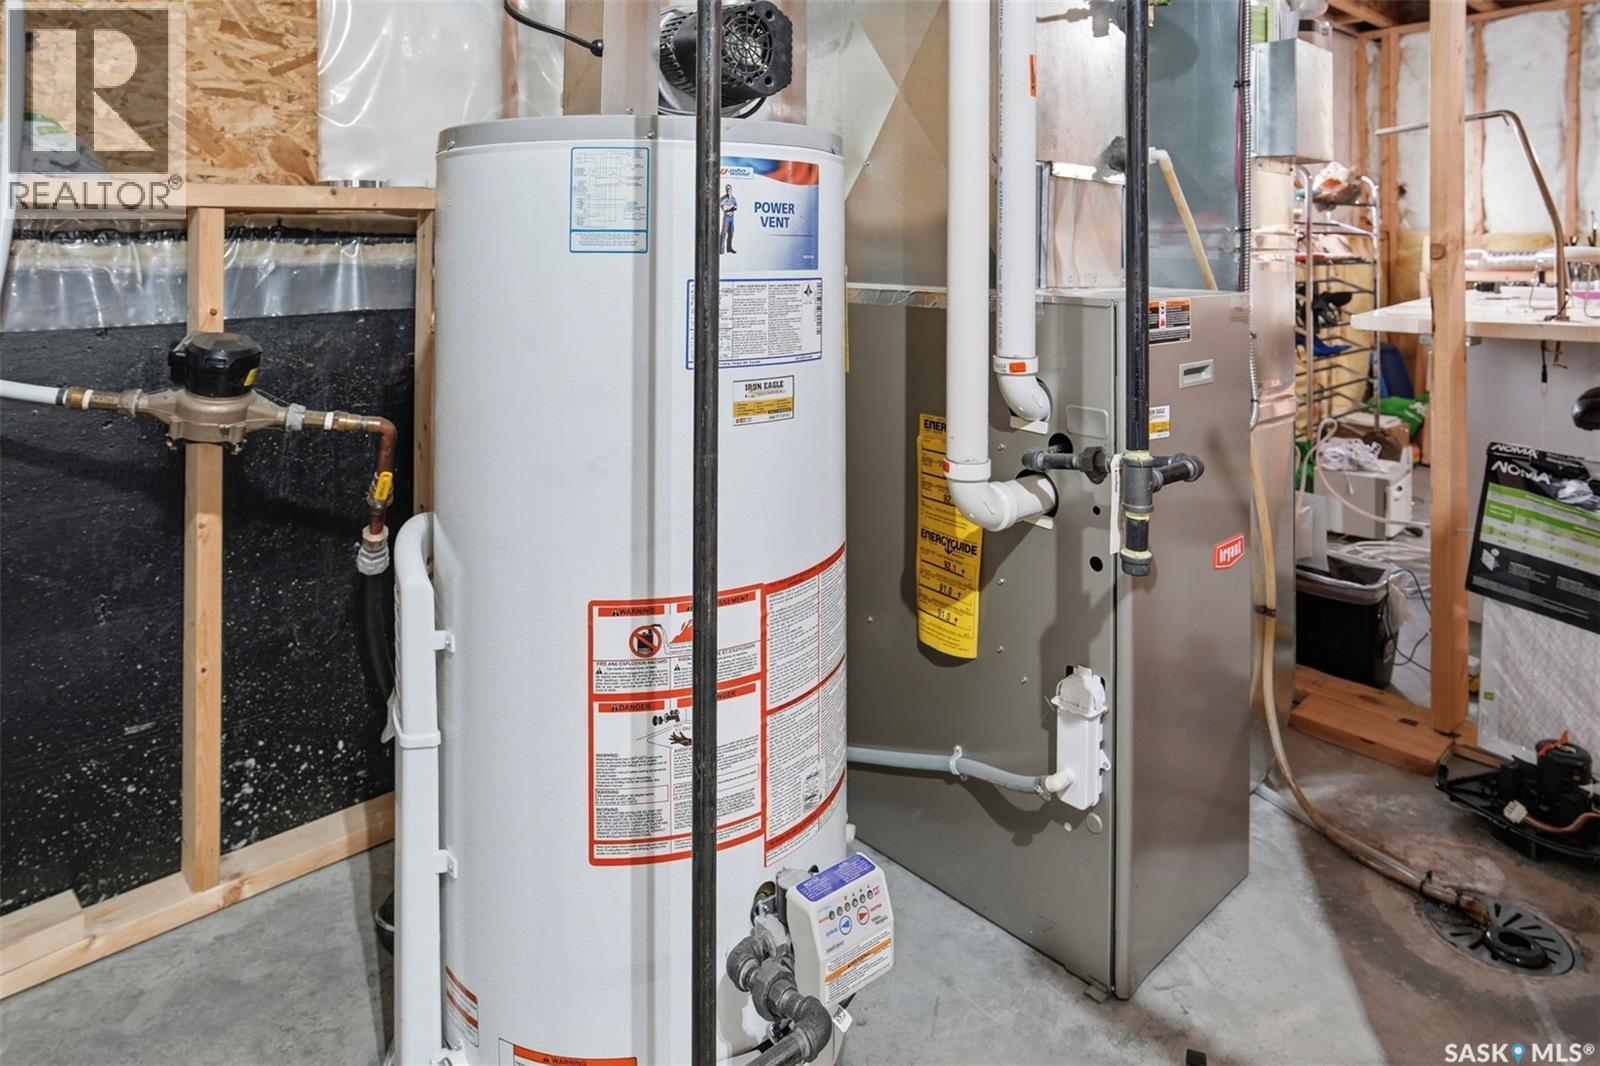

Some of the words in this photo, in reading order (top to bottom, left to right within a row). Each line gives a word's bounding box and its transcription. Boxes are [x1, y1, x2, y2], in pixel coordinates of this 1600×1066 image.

[754, 201, 795, 215] POWER
[760, 215, 790, 229] VENT
[744, 382, 762, 391] IRON
[764, 380, 784, 389] EAGLE
[1491, 444, 1538, 459] NOMA
[1491, 460, 1551, 485] NOMA
[1219, 540, 1242, 564] bryant
[620, 607, 655, 616] WARNING
[619, 703, 651, 712] DANGER
